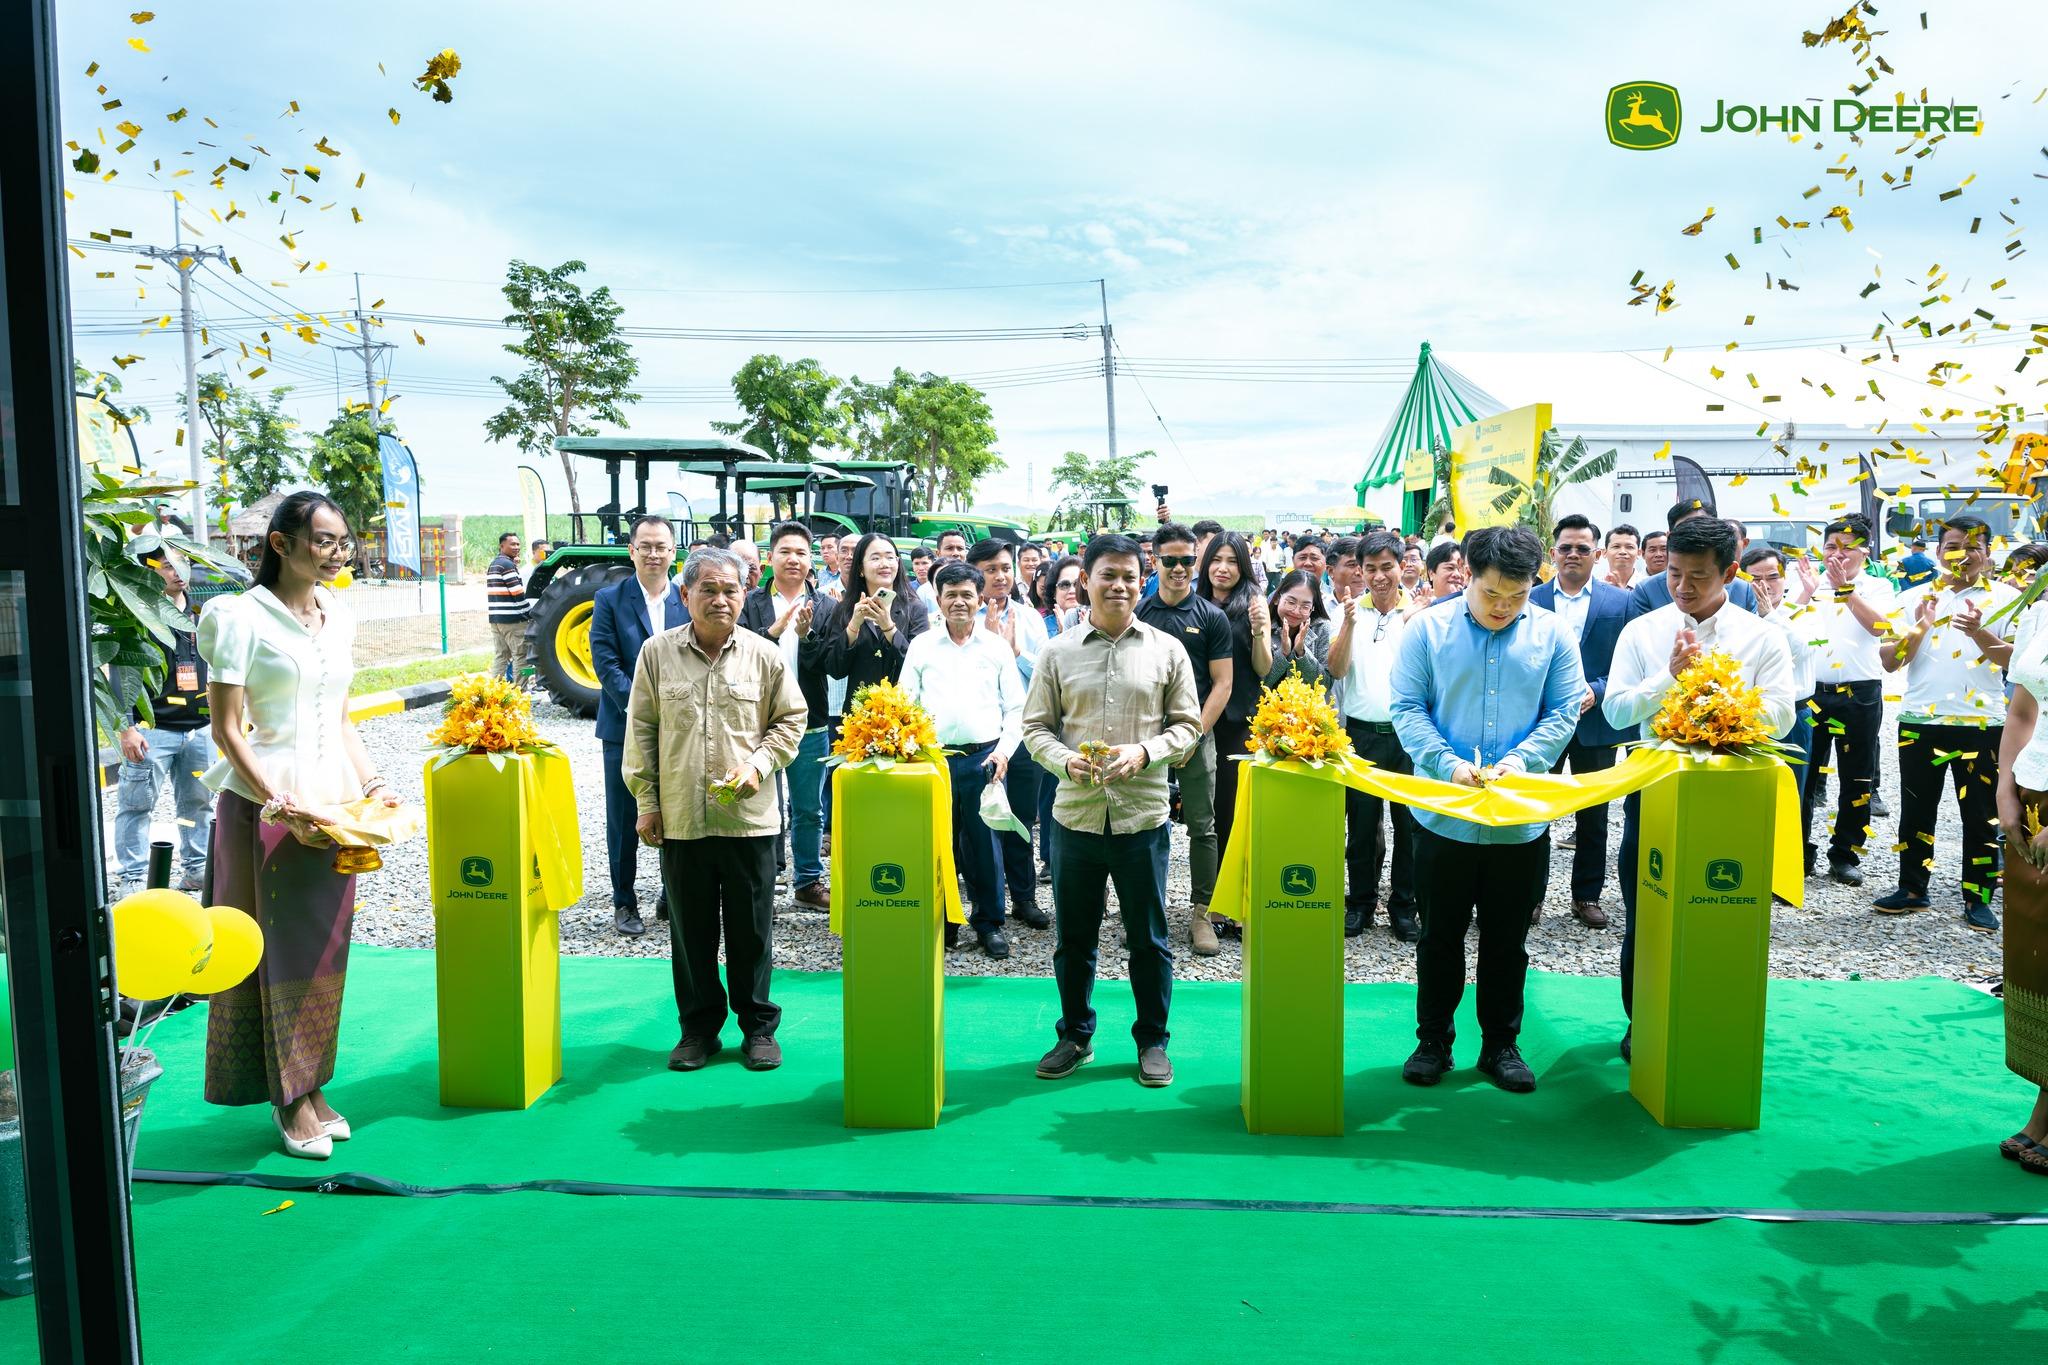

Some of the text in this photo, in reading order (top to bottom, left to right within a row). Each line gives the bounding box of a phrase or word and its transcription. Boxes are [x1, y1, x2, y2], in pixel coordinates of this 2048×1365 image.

[447, 889, 508, 900] JOHN DEERE
[856, 898, 920, 908] JOHN DEERE
[1265, 900, 1332, 909] JOHN DEERE
[1688, 895, 1757, 905] JOHN DEERE
